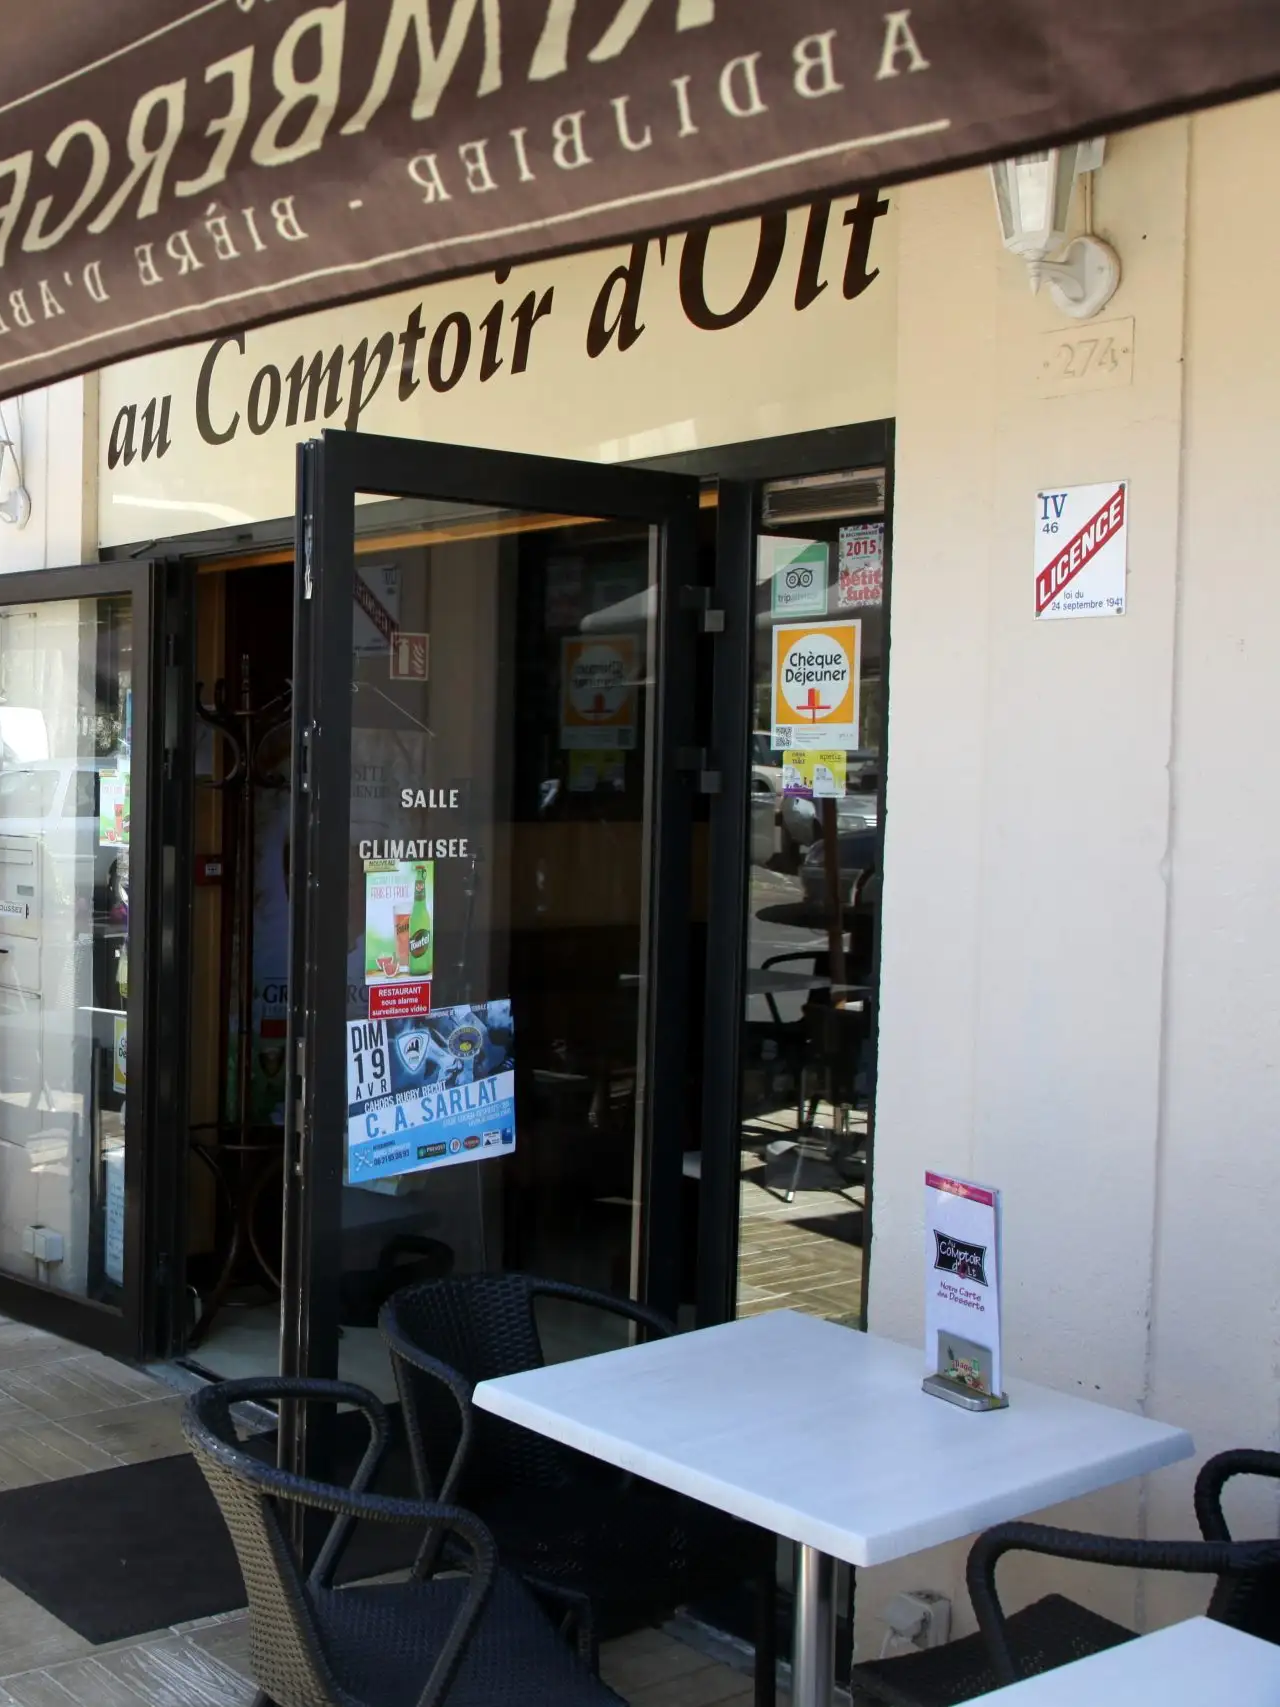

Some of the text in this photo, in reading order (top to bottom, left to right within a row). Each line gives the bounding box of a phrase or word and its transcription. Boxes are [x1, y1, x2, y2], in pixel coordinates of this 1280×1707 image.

[107, 188, 891, 471] au Comptoir d'Olt
[1041, 493, 1068, 520] IV
[1042, 522, 1059, 534] 46
[846, 539, 877, 557] 2015
[1039, 495, 1122, 606] LICENCE
[1051, 597, 1123, 612] 24 septembre 1941
[1063, 589, 1084, 600] loi du
[789, 650, 842, 669] Chèque
[785, 667, 847, 686] Déjeuner
[401, 788, 459, 808] SALLE
[359, 838, 469, 859] CLIMATISEE
[378, 986, 422, 998] RESTAURANT
[397, 997, 419, 1005] alarme
[351, 1020, 384, 1053] DIM
[354, 1048, 386, 1084] 19
[355, 1078, 388, 1100] AVR
[364, 1095, 394, 1113] CAHORS
[395, 1087, 421, 1106] RUGBY
[365, 1112, 386, 1139] C.
[394, 1104, 415, 1131] A.
[421, 1076, 498, 1122] SARLAT
[940, 1280, 982, 1302] Notre Carte
[949, 1292, 985, 1312] Desserts
